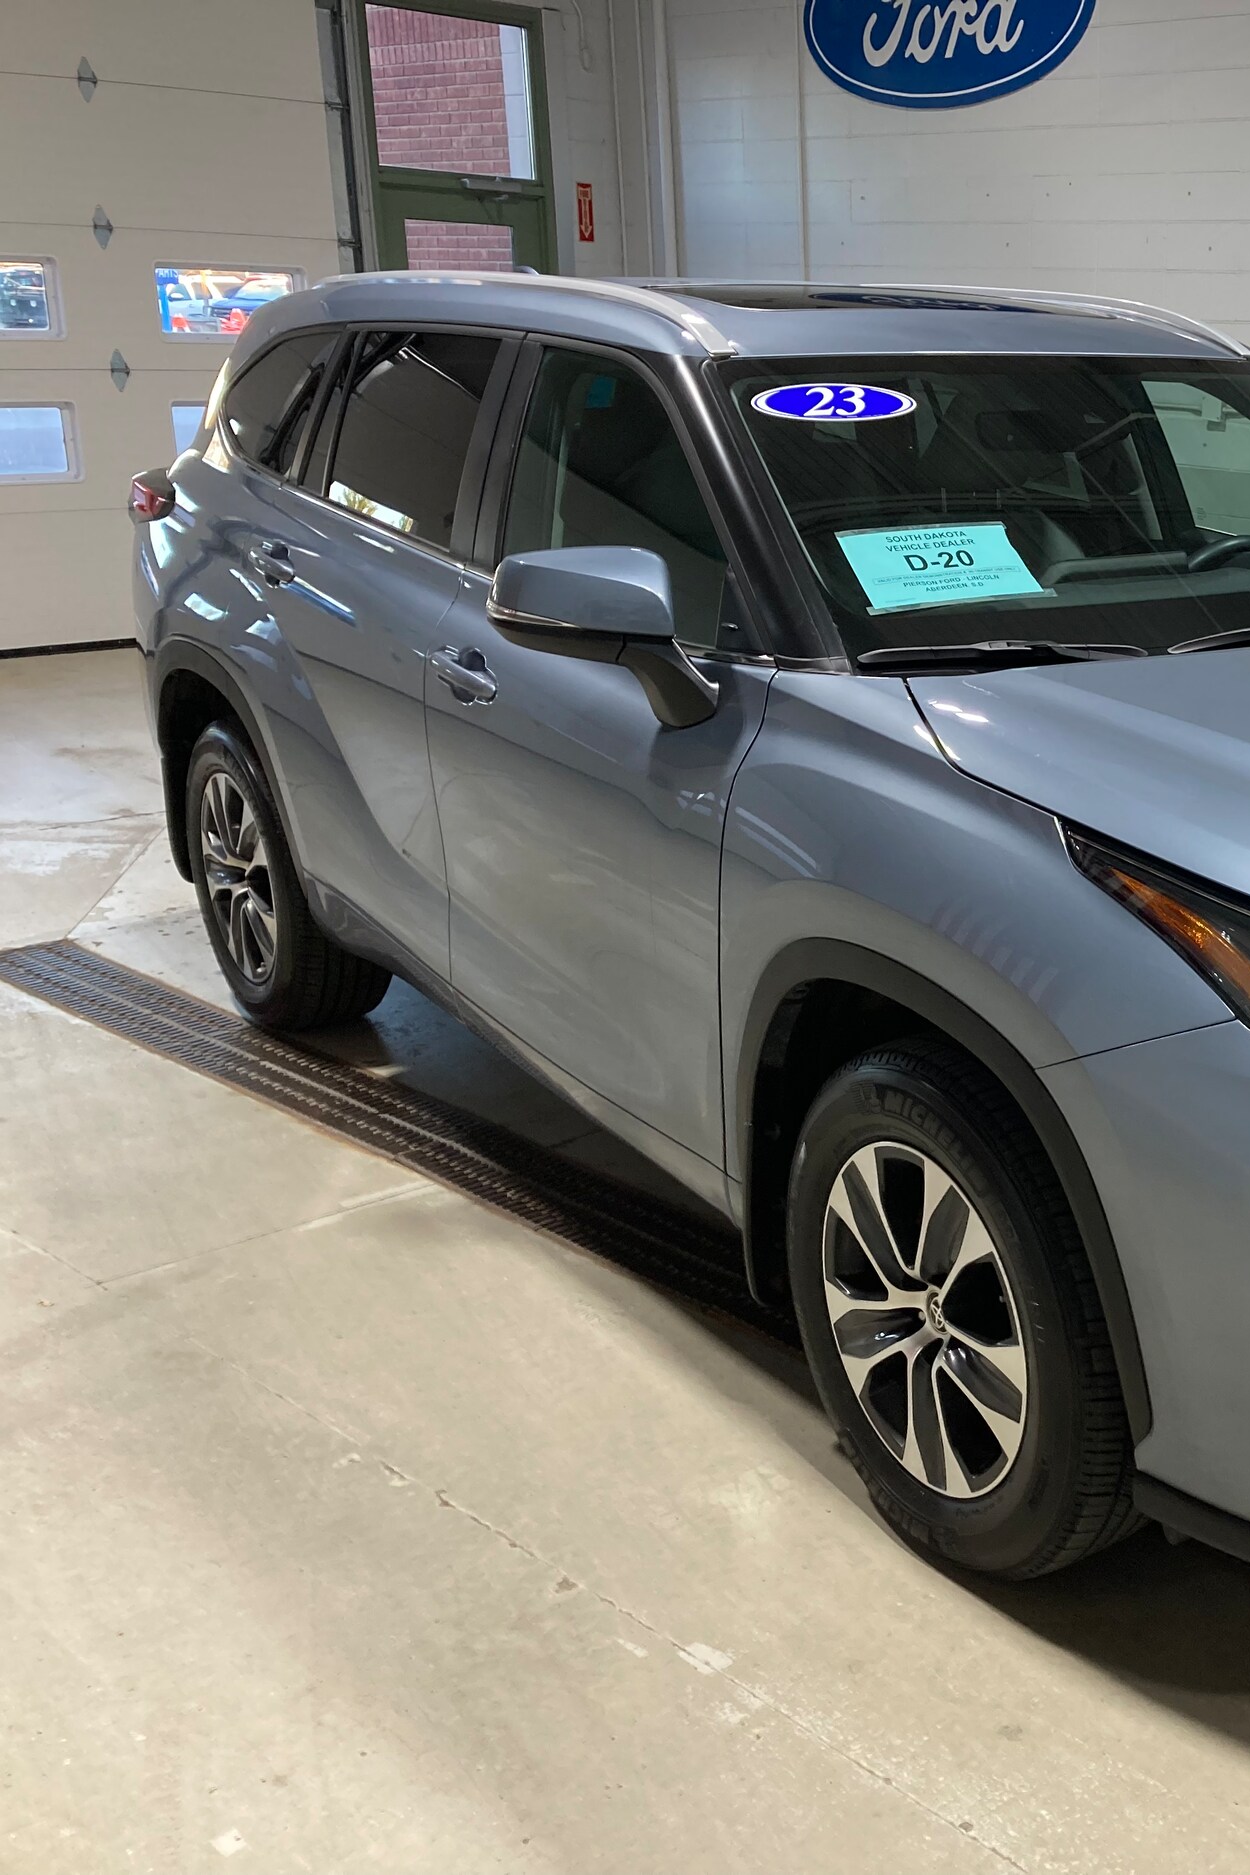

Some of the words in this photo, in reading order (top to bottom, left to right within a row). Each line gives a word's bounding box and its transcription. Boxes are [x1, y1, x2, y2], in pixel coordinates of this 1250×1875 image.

[862, 0, 1024, 67] Ford
[802, 386, 867, 417] 23
[885, 534, 922, 543] SOUTH
[923, 530, 967, 540] DAKOTA
[885, 542, 932, 552] VEHICLE
[933, 538, 976, 549] DEALER
[903, 549, 975, 572] D-20
[902, 579, 938, 588] PIERSON
[966, 574, 1000, 582] LINCOLN
